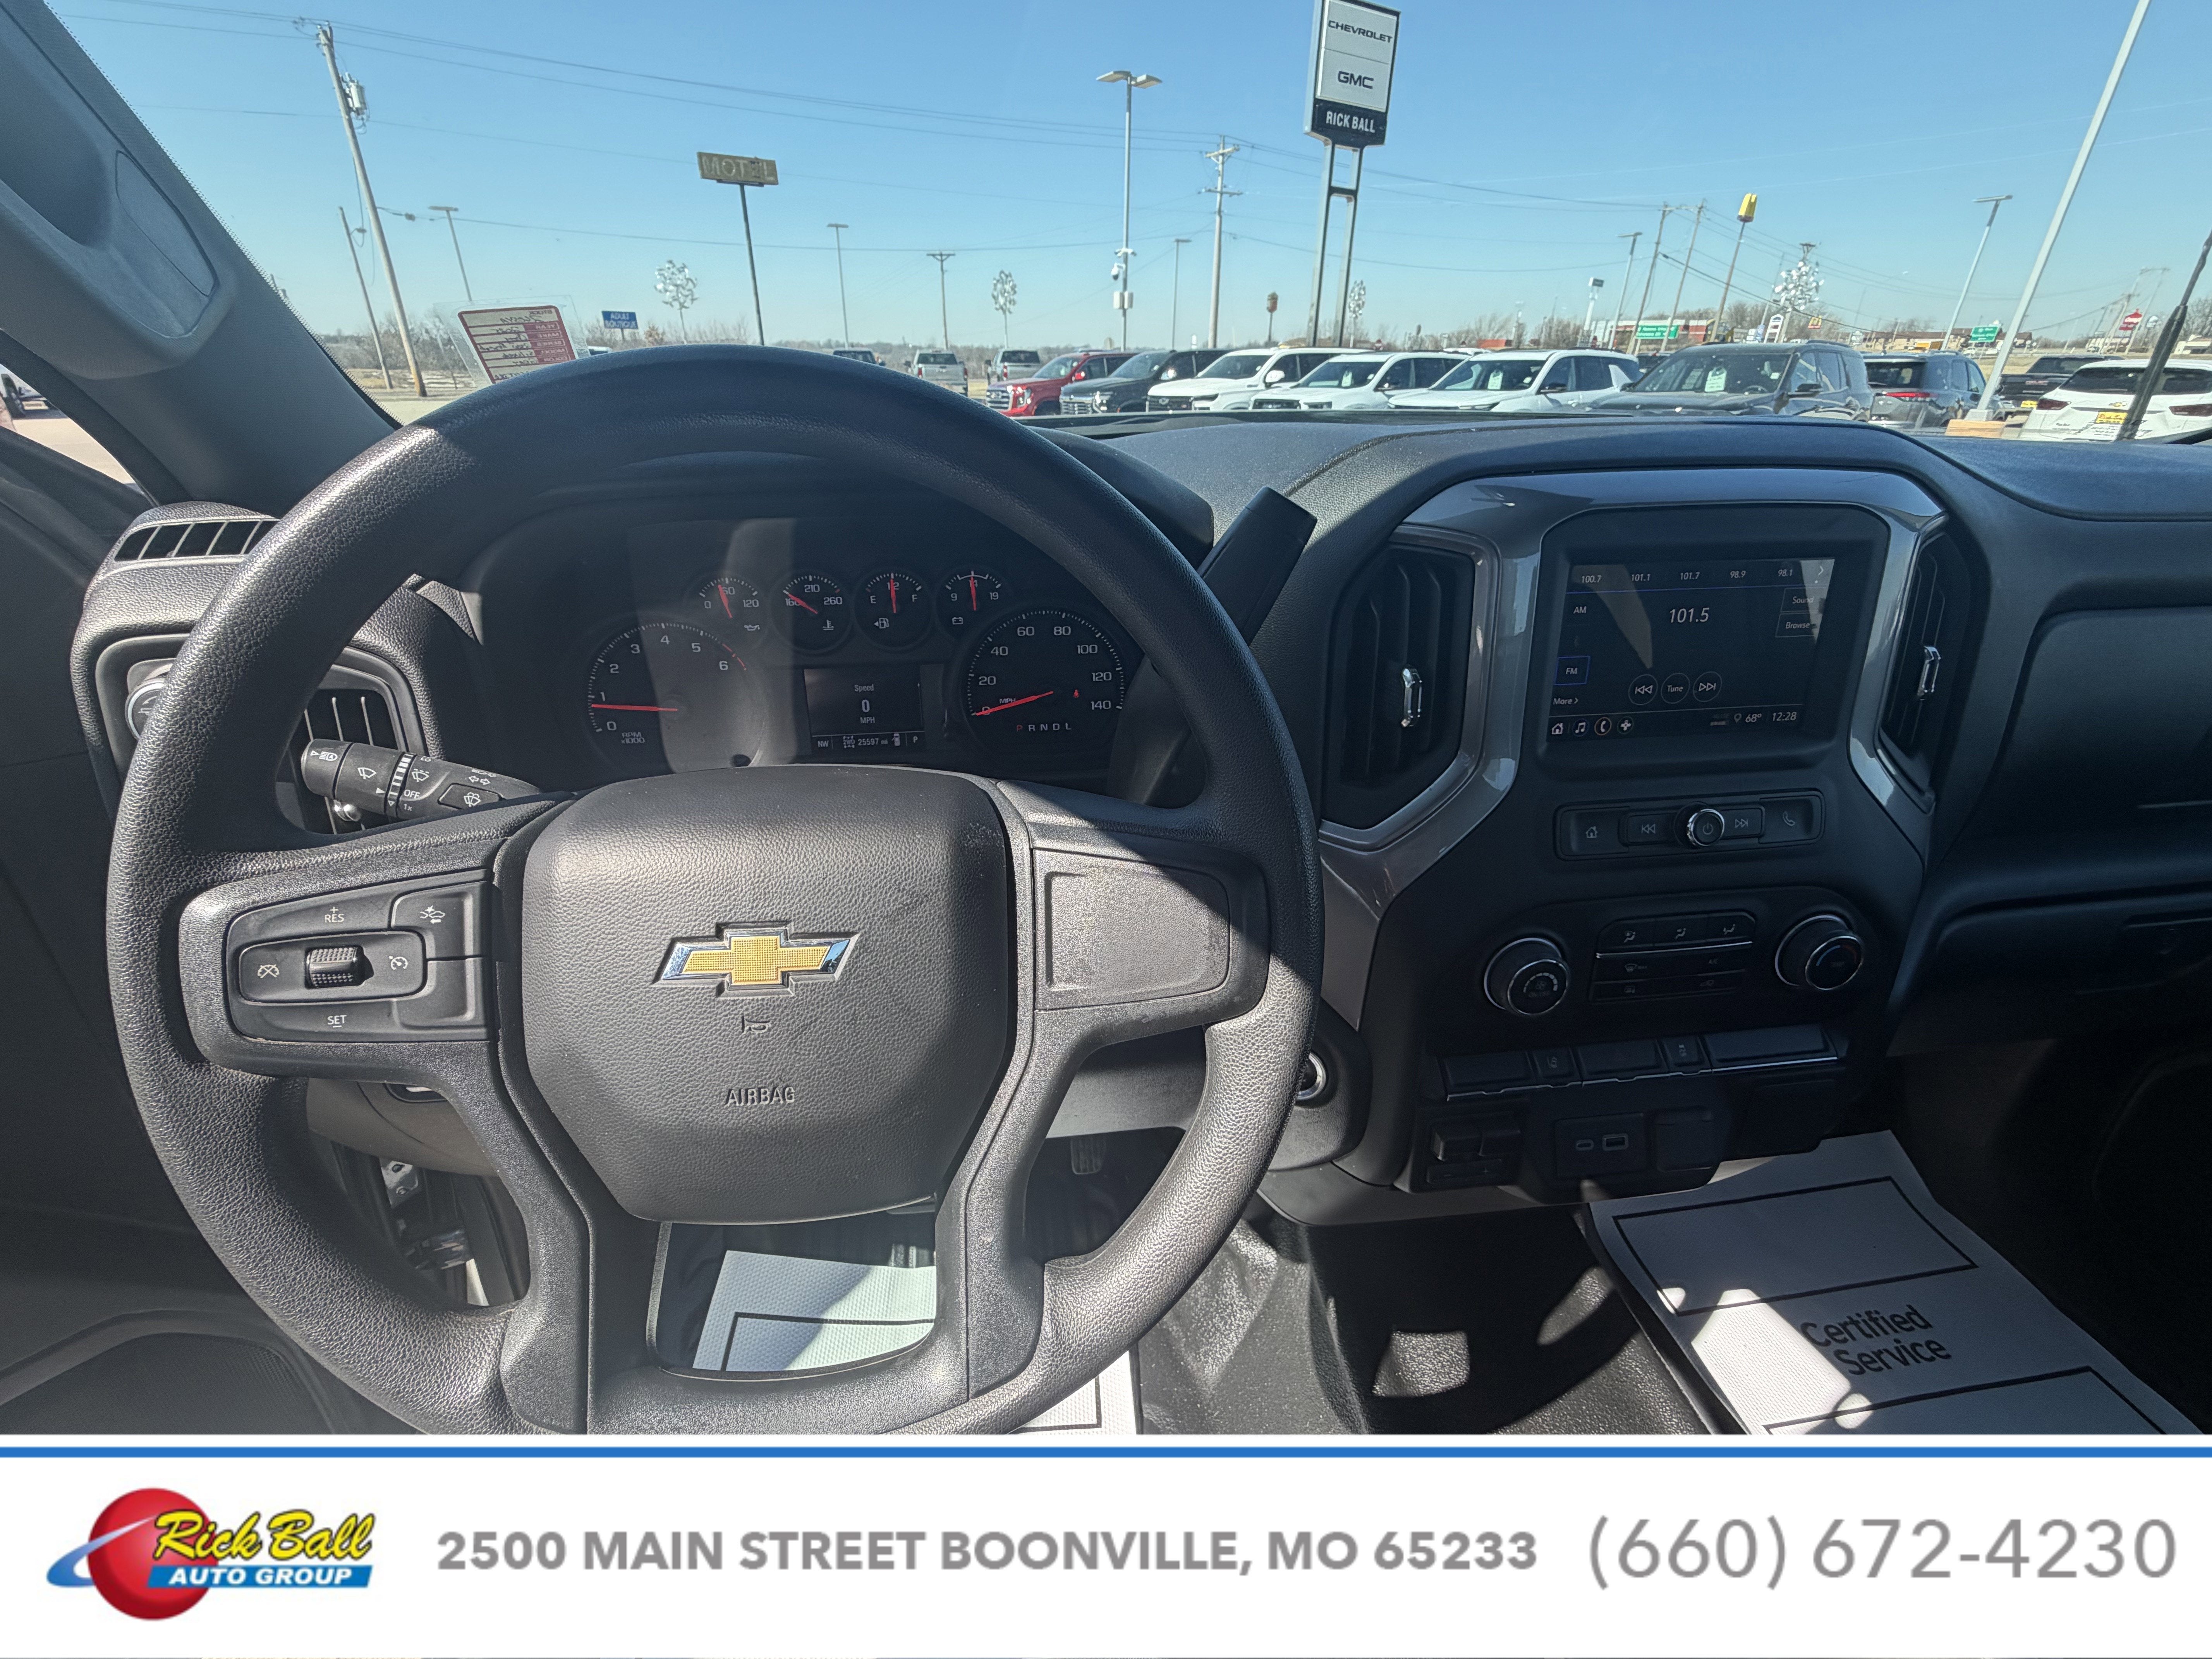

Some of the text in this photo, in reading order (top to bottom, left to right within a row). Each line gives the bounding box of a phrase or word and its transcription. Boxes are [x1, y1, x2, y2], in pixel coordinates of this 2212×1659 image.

[1328, 20, 1393, 43] CHEVROLET
[1338, 71, 1374, 89] GMC
[1326, 111, 1375, 133] RICK BALL
[1680, 572, 1700, 580] 101.7
[804, 584, 820, 592] 210
[743, 599, 759, 608] 120
[824, 597, 842, 605] 260
[1669, 607, 1709, 623] 101.5
[1017, 627, 1035, 636] 60
[1054, 626, 1071, 635] 80
[660, 635, 670, 644] 4
[630, 644, 640, 653] 3
[692, 642, 701, 652] 5
[991, 646, 1008, 656] 40
[1077, 644, 1098, 654] 100
[610, 663, 619, 673] 2
[719, 661, 728, 670] 6
[979, 676, 996, 685] 20
[1092, 672, 1112, 682] 120
[854, 684, 874, 692] Speed
[1667, 684, 1683, 692] Tune
[600, 692, 605, 701] 1
[862, 699, 870, 713] 0
[1091, 700, 1111, 710] 140
[1772, 712, 1797, 721] 12:28
[606, 721, 617, 730] 0
[404, 789, 420, 799] OFF
[325, 914, 344, 923] RES
[327, 1015, 347, 1025] SET
[725, 1087, 794, 1107] AIRBAG
[1800, 1304, 1933, 1347] Certified
[1833, 1339, 1952, 1375] Service
